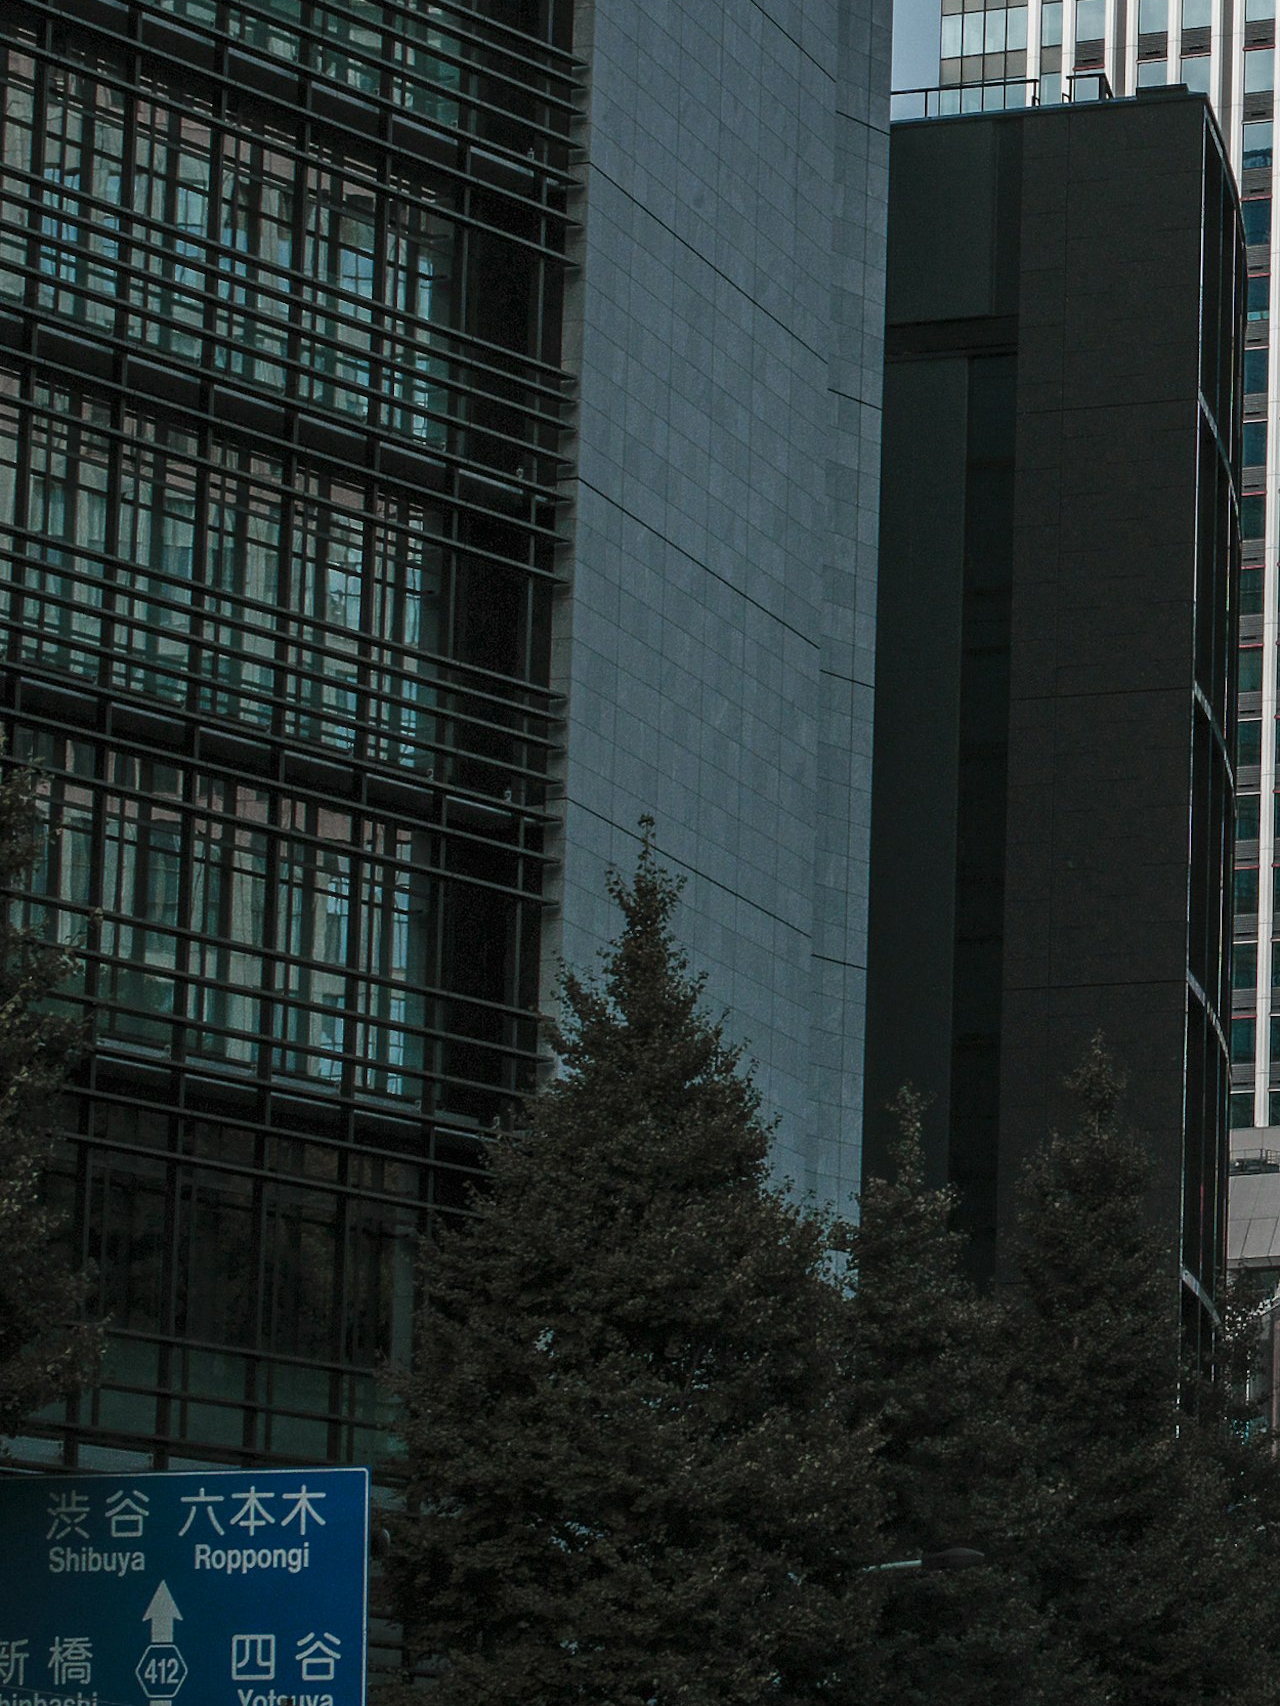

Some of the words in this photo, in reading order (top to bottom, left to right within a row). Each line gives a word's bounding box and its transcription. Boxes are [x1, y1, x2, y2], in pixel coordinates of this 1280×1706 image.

[46, 1490, 150, 1539] 渋谷
[178, 1485, 326, 1536] 六本木
[48, 1547, 145, 1577] Shibuya
[194, 1542, 310, 1574] Roppongi
[0, 1636, 94, 1686] 新橋
[144, 1659, 179, 1685] 412
[231, 1632, 341, 1681] 四谷
